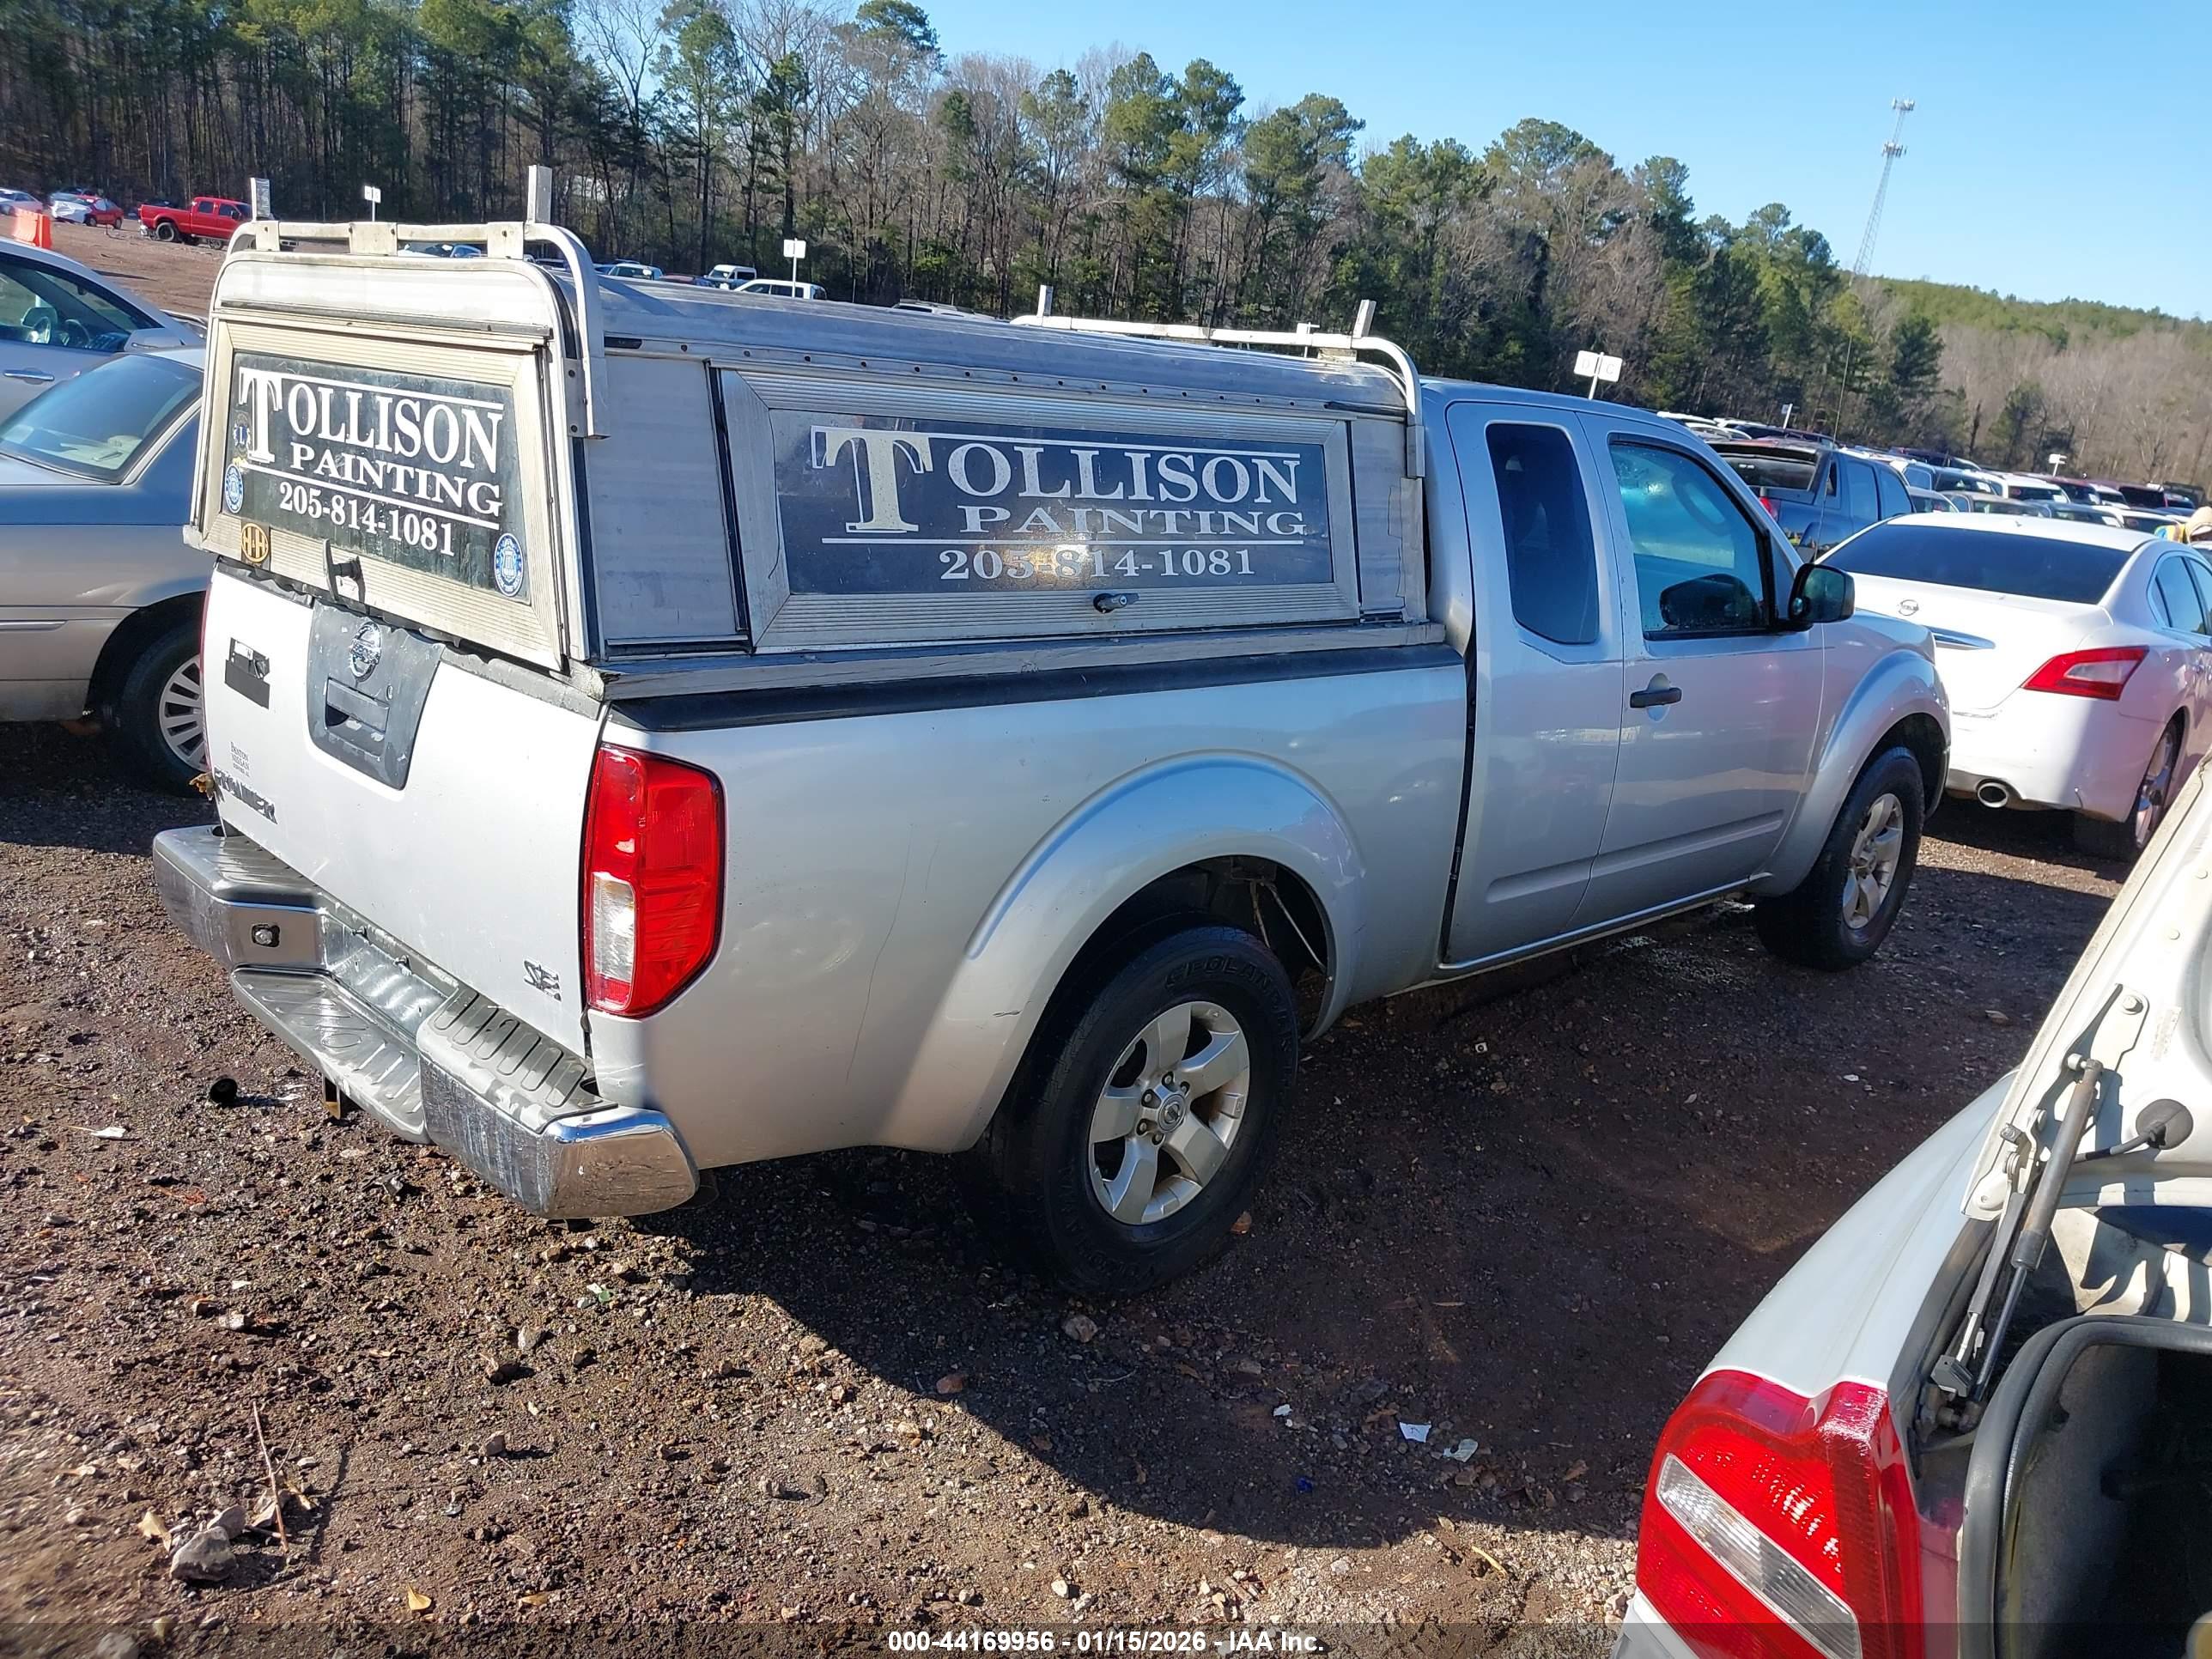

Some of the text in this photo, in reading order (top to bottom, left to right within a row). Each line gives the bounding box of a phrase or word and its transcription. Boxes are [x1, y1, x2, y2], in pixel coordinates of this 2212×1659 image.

[239, 368, 503, 474] TOLLISON
[291, 442, 503, 517] PAINTING
[811, 426, 1300, 534] TOLLISON
[279, 482, 454, 557] 205-814-1081
[957, 505, 1306, 535] PAINTING
[939, 548, 1255, 580] 205-814-1081
[214, 766, 277, 824] FRONER
[524, 960, 562, 1002] SE
